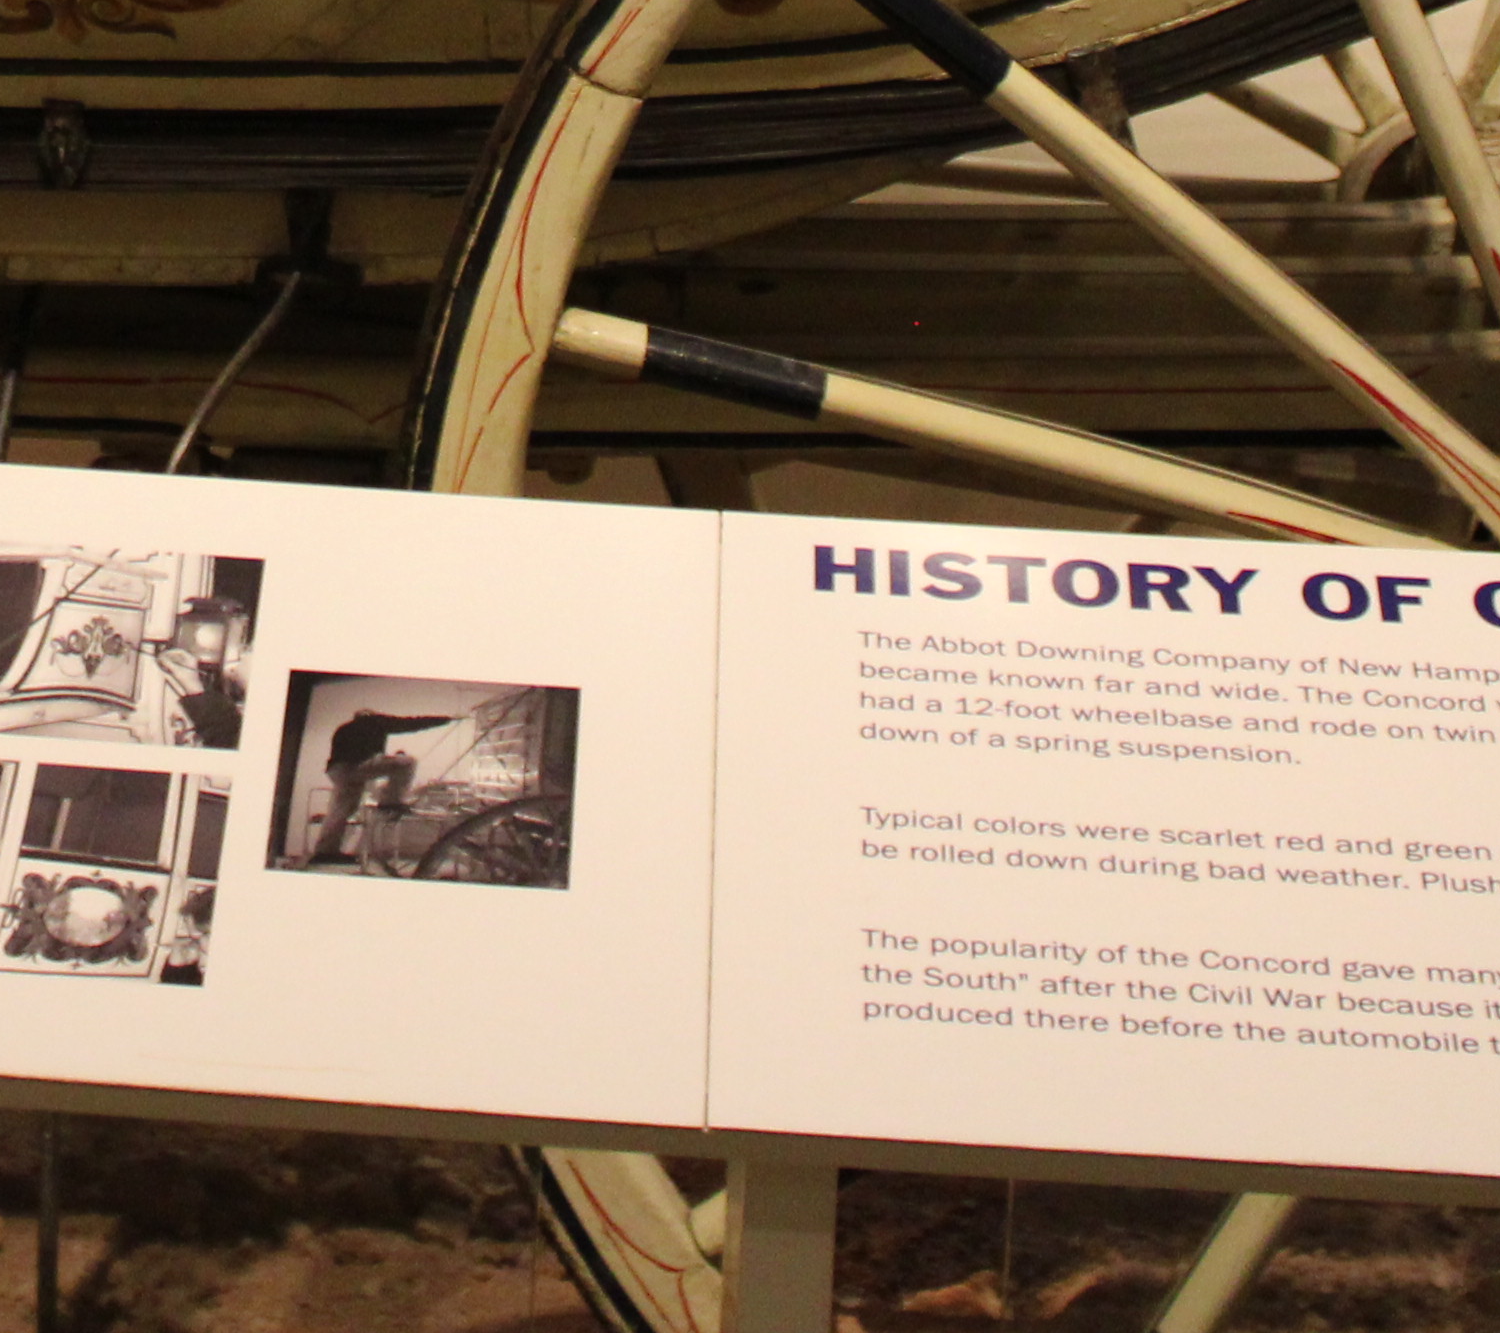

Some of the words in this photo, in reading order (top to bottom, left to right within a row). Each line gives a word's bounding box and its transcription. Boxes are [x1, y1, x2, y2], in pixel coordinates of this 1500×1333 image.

[815, 547, 1256, 614] HISTORY
[1302, 573, 1430, 623] OF
[857, 629, 912, 651] The
[919, 633, 1006, 657] Abbot
[1014, 638, 1145, 669] Downing
[1150, 646, 1290, 677] Company
[1297, 655, 1328, 674] of
[1336, 655, 1402, 678] New
[857, 720, 938, 744] down
[946, 725, 978, 746] of
[986, 730, 1006, 748] a
[1013, 732, 1111, 759] spring
[1116, 739, 1300, 765] suspension.
[861, 926, 919, 952] The
[928, 935, 1087, 967] popularity
[1095, 943, 1127, 965] of
[1135, 944, 1189, 968] the
[1198, 947, 1331, 976] Concord
[1340, 959, 1415, 983] gave
[861, 1000, 1014, 1026] produced
[1022, 1006, 1108, 1032] there
[1118, 1012, 1223, 1039] before
[1231, 1019, 1286, 1044] the
[1296, 1025, 1479, 1054] automobile
